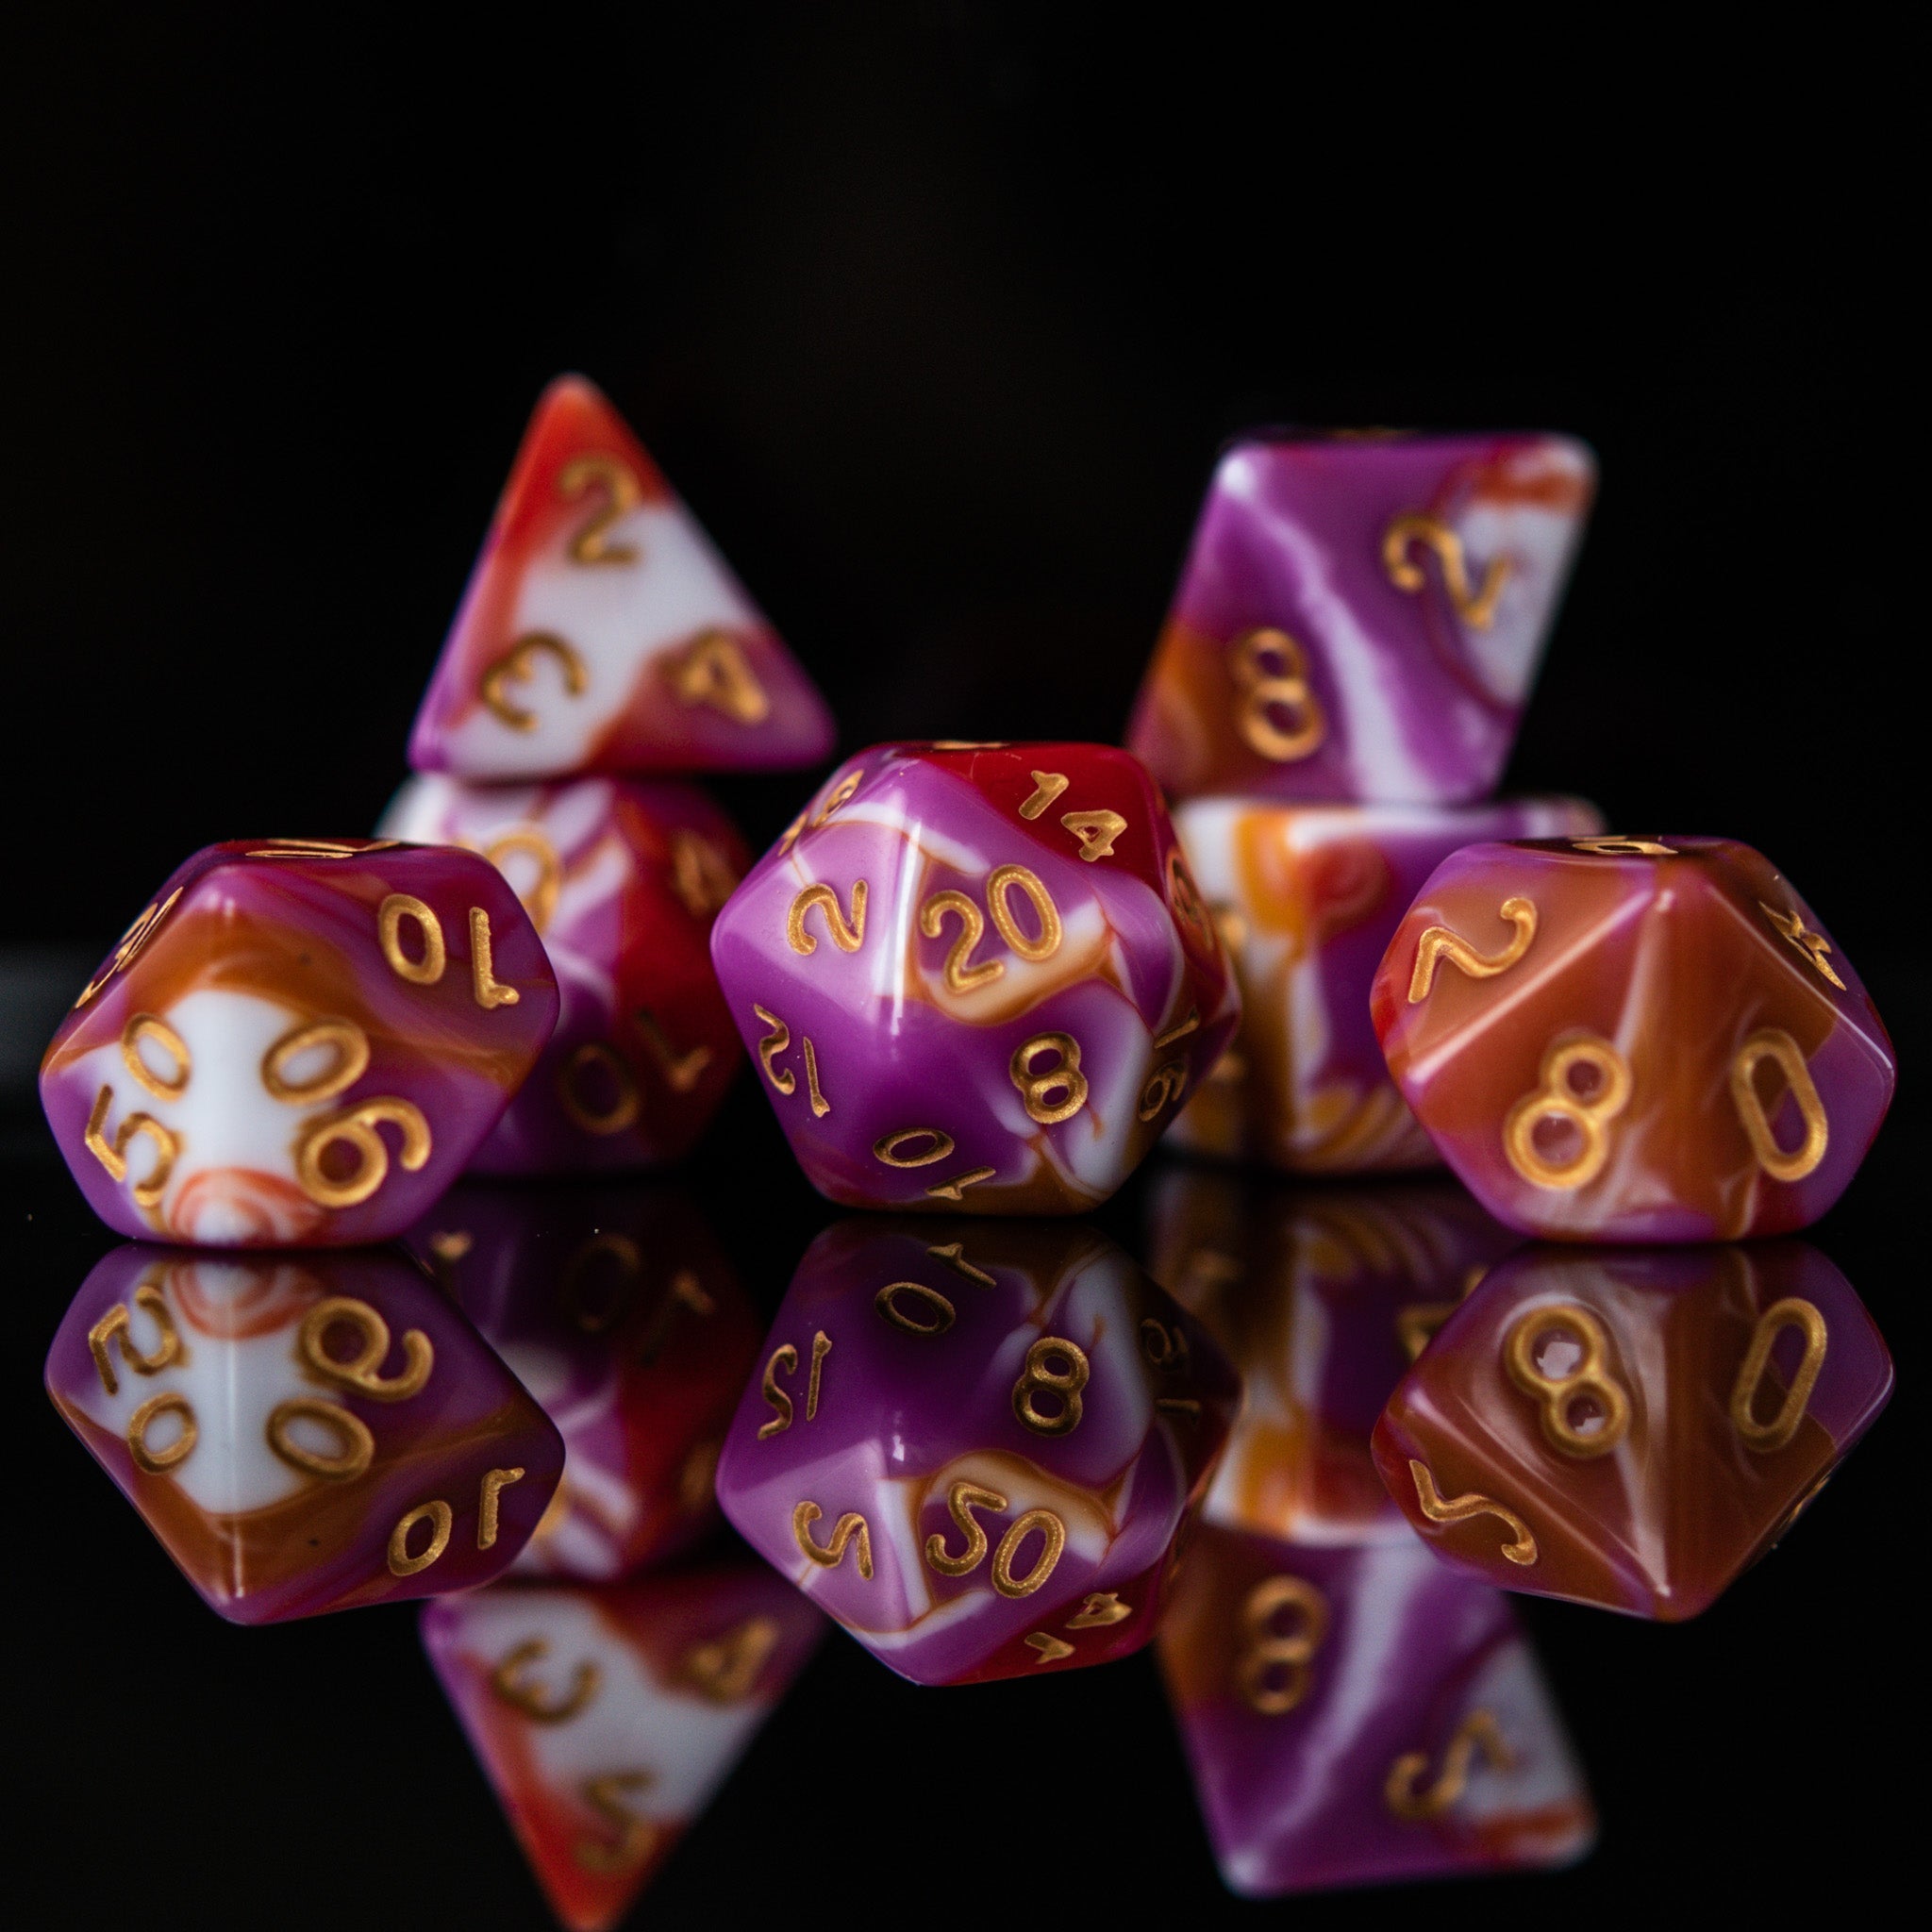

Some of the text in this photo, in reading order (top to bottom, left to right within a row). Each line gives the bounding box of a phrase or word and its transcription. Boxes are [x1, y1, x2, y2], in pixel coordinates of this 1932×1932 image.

[559, 453, 641, 564] 2
[1383, 517, 1515, 632] 2
[482, 632, 584, 733] 3
[672, 630, 768, 724] 4
[1234, 626, 1326, 762] 8
[1018, 769, 1128, 861] 14
[378, 892, 521, 1010] 10
[787, 879, 869, 957] 2
[921, 863, 1062, 994] 20
[753, 1003, 831, 1119] 12
[1008, 1030, 1090, 1125] 8
[1504, 1036, 1633, 1191] 8
[1729, 1025, 1829, 1182] 0
